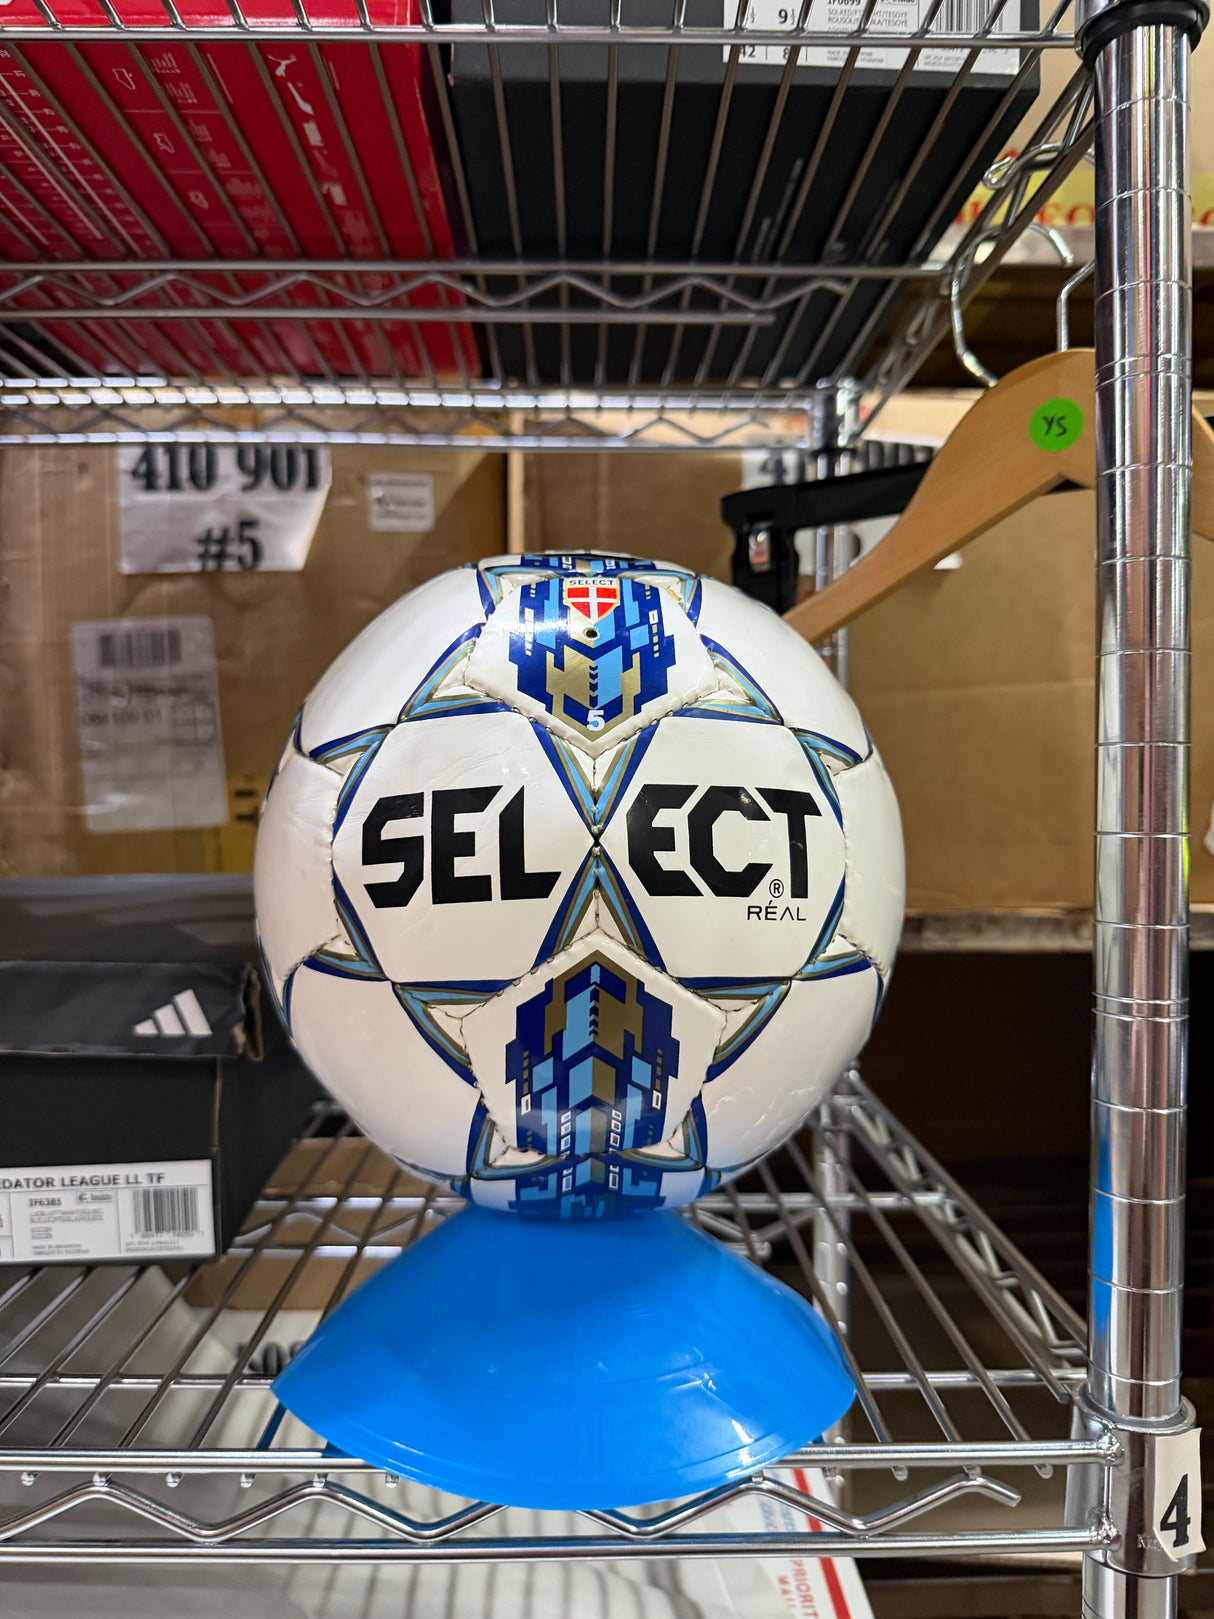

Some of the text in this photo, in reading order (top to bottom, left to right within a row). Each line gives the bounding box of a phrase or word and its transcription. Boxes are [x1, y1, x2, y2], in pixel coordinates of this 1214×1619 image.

[1042, 415, 1067, 437] YS
[131, 442, 321, 492] 410 901
[196, 516, 264, 571] #5
[586, 710, 605, 731] 5
[361, 784, 823, 909] SELECT
[747, 899, 807, 921] RÉAL
[0, 1172, 166, 1190] DATOR LEAGUE LL TF
[1159, 1473, 1191, 1548] 4
[788, 1558, 819, 1619] PRIORIT
